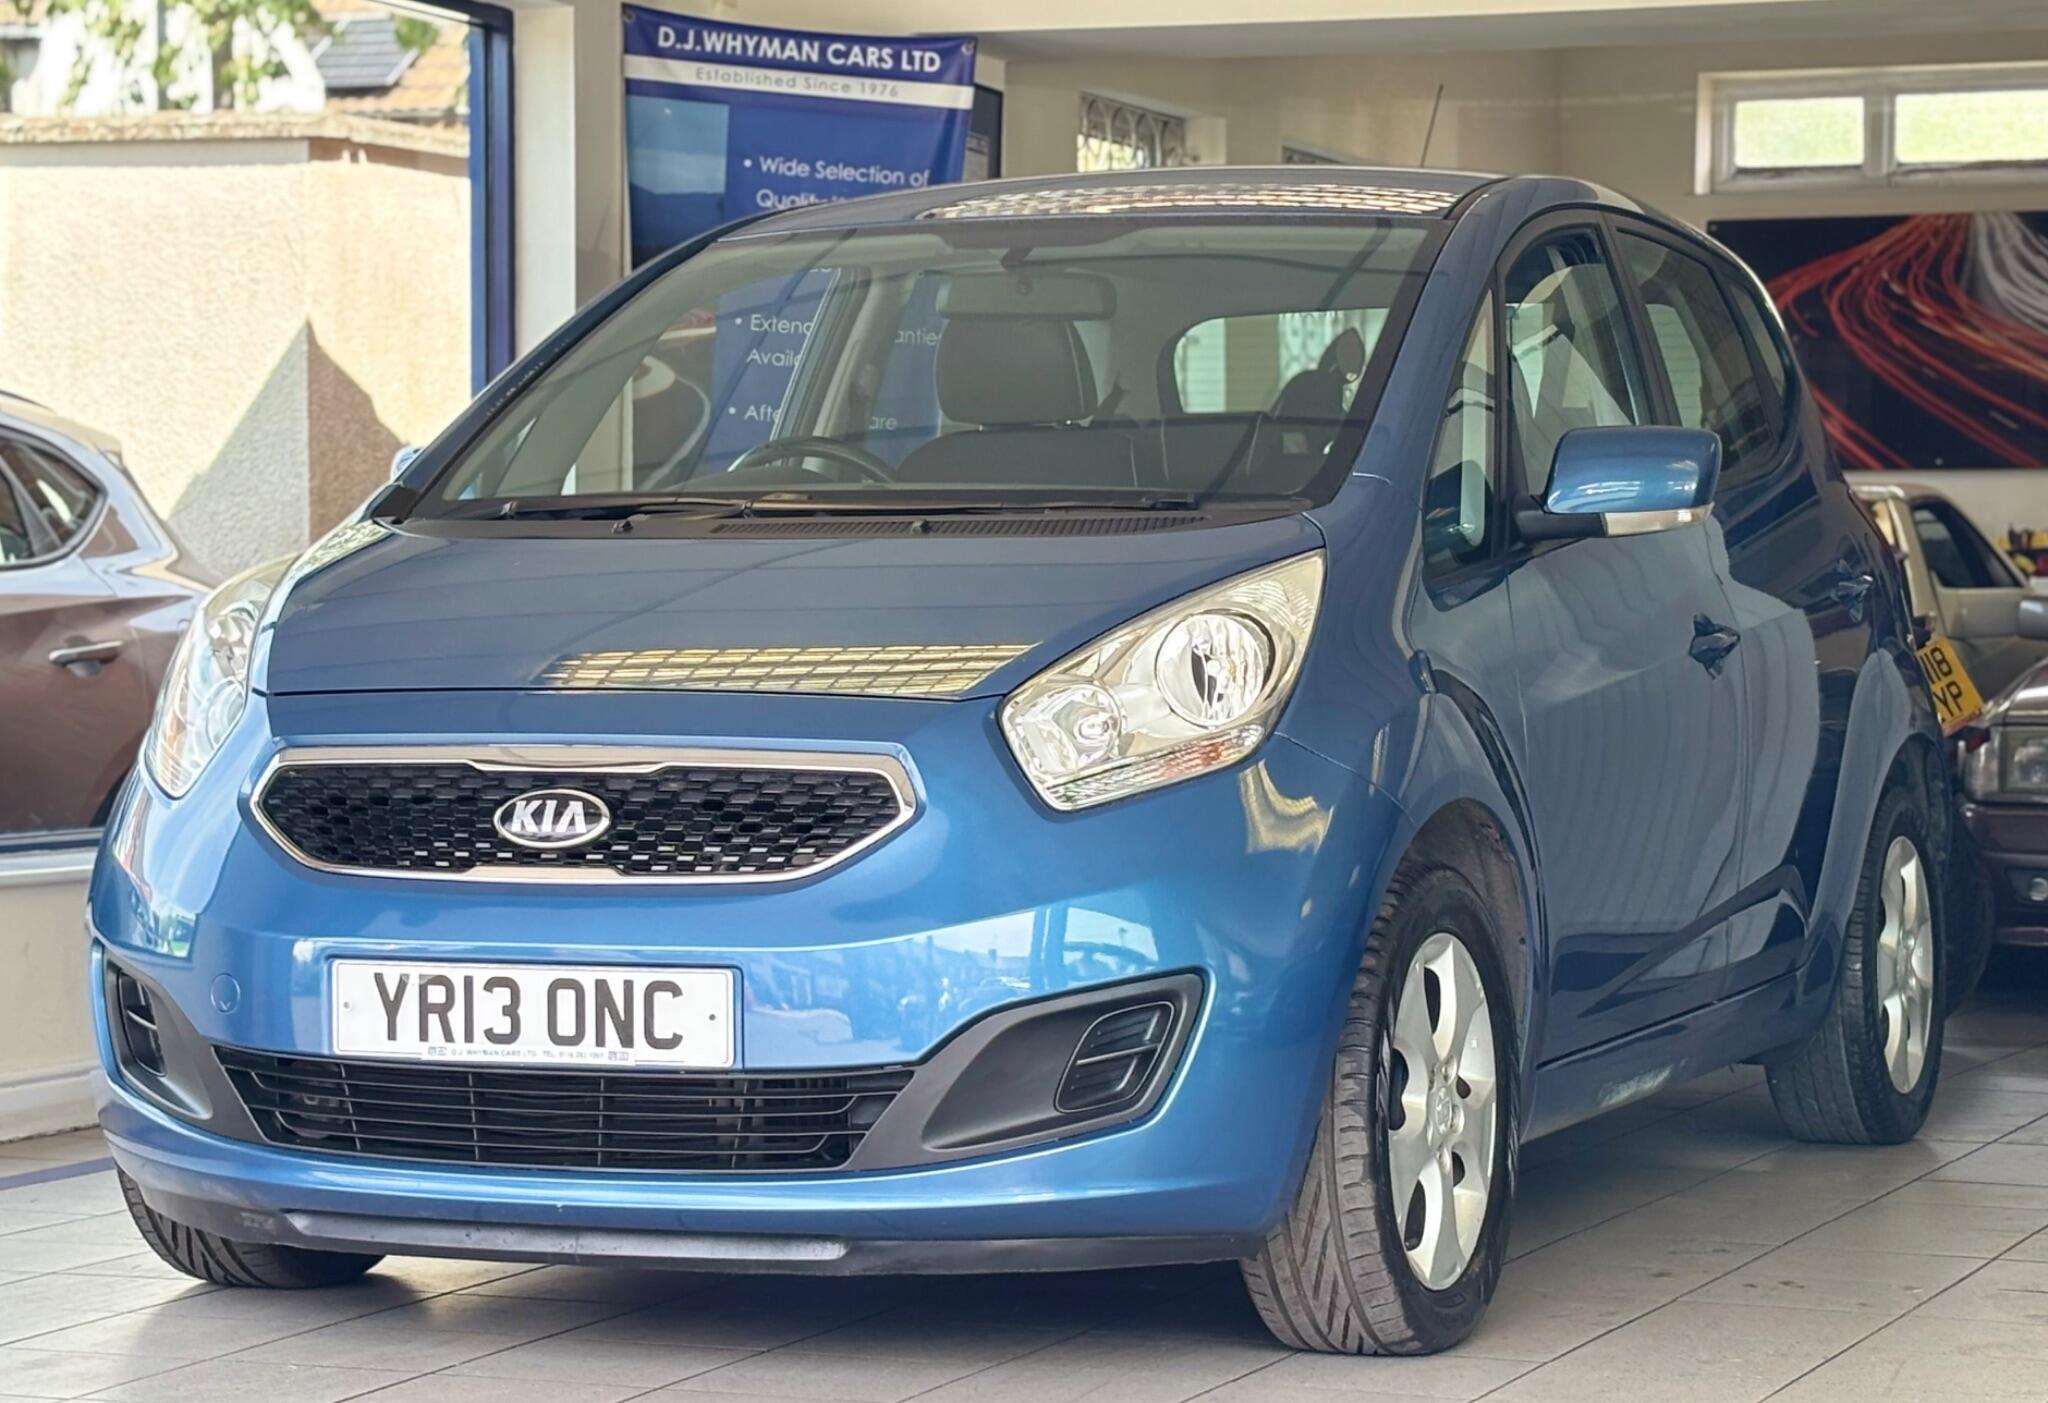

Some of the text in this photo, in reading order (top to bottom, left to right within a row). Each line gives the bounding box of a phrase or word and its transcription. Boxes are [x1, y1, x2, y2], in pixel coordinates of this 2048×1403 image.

[657, 25, 941, 72] D.J.WHYMAN CARS LTD
[695, 66, 898, 98] Established Since 1976
[759, 156, 930, 188] Wide Selection of
[756, 188, 827, 210] Qualit
[1919, 647, 1953, 685] 118
[1932, 680, 1963, 719] YP
[511, 799, 587, 833] KIA
[373, 972, 684, 1050] YR13 ONC
